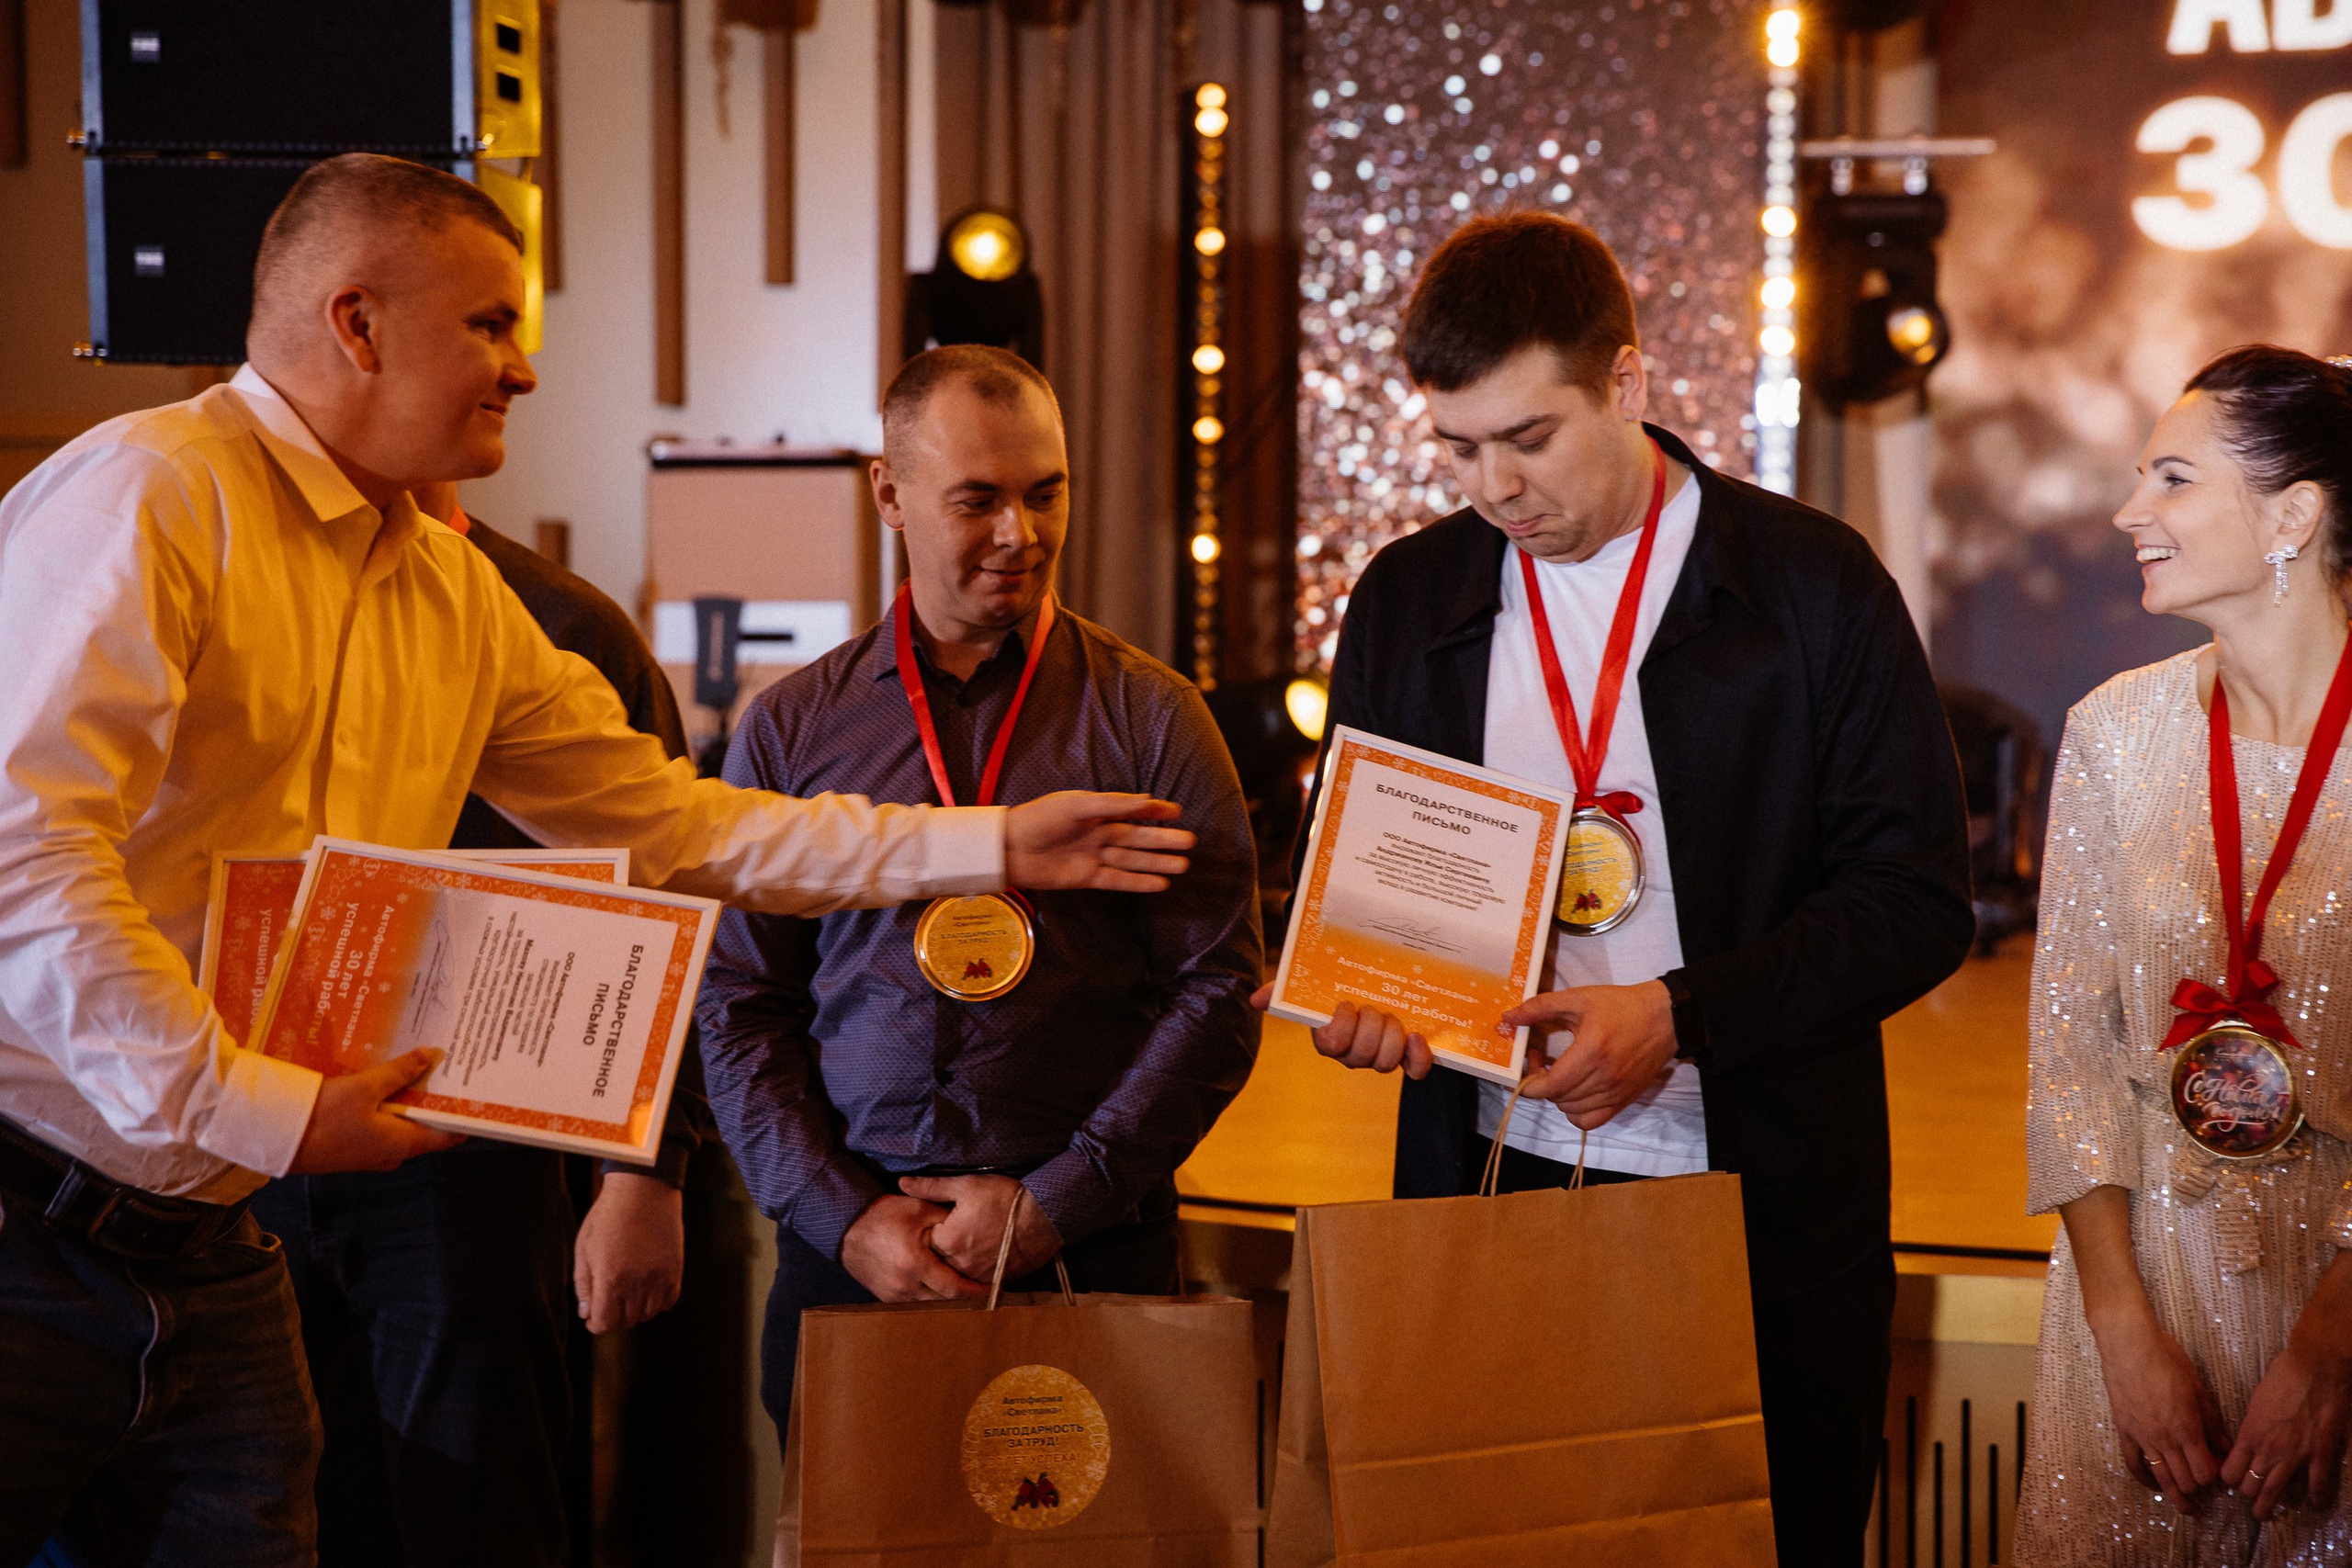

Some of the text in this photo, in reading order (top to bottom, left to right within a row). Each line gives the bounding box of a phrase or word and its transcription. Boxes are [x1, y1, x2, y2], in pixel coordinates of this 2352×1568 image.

[1375, 784, 1518, 833] БЛАГОДАРСТВЕННОЕ
[1411, 810, 1471, 835] ПИСЬМО
[254, 908, 272, 985] успешной
[326, 901, 359, 978] успешной
[362, 904, 394, 977] Автофирма
[336, 949, 363, 998] 30 лет
[1336, 955, 1408, 984] Автофирма
[1380, 981, 1429, 1004] 30 лет
[582, 982, 610, 1046] ПИСЬМО
[592, 943, 644, 1098] БЛАГОДАРСТВЕННОЕ
[1333, 981, 1473, 1029] успешной работы!
[1002, 1395, 1063, 1405] Автофирма
[983, 1424, 1084, 1438] БЛАГОДАРНОСТЬ
[1008, 1438, 1023, 1448] ЗА
